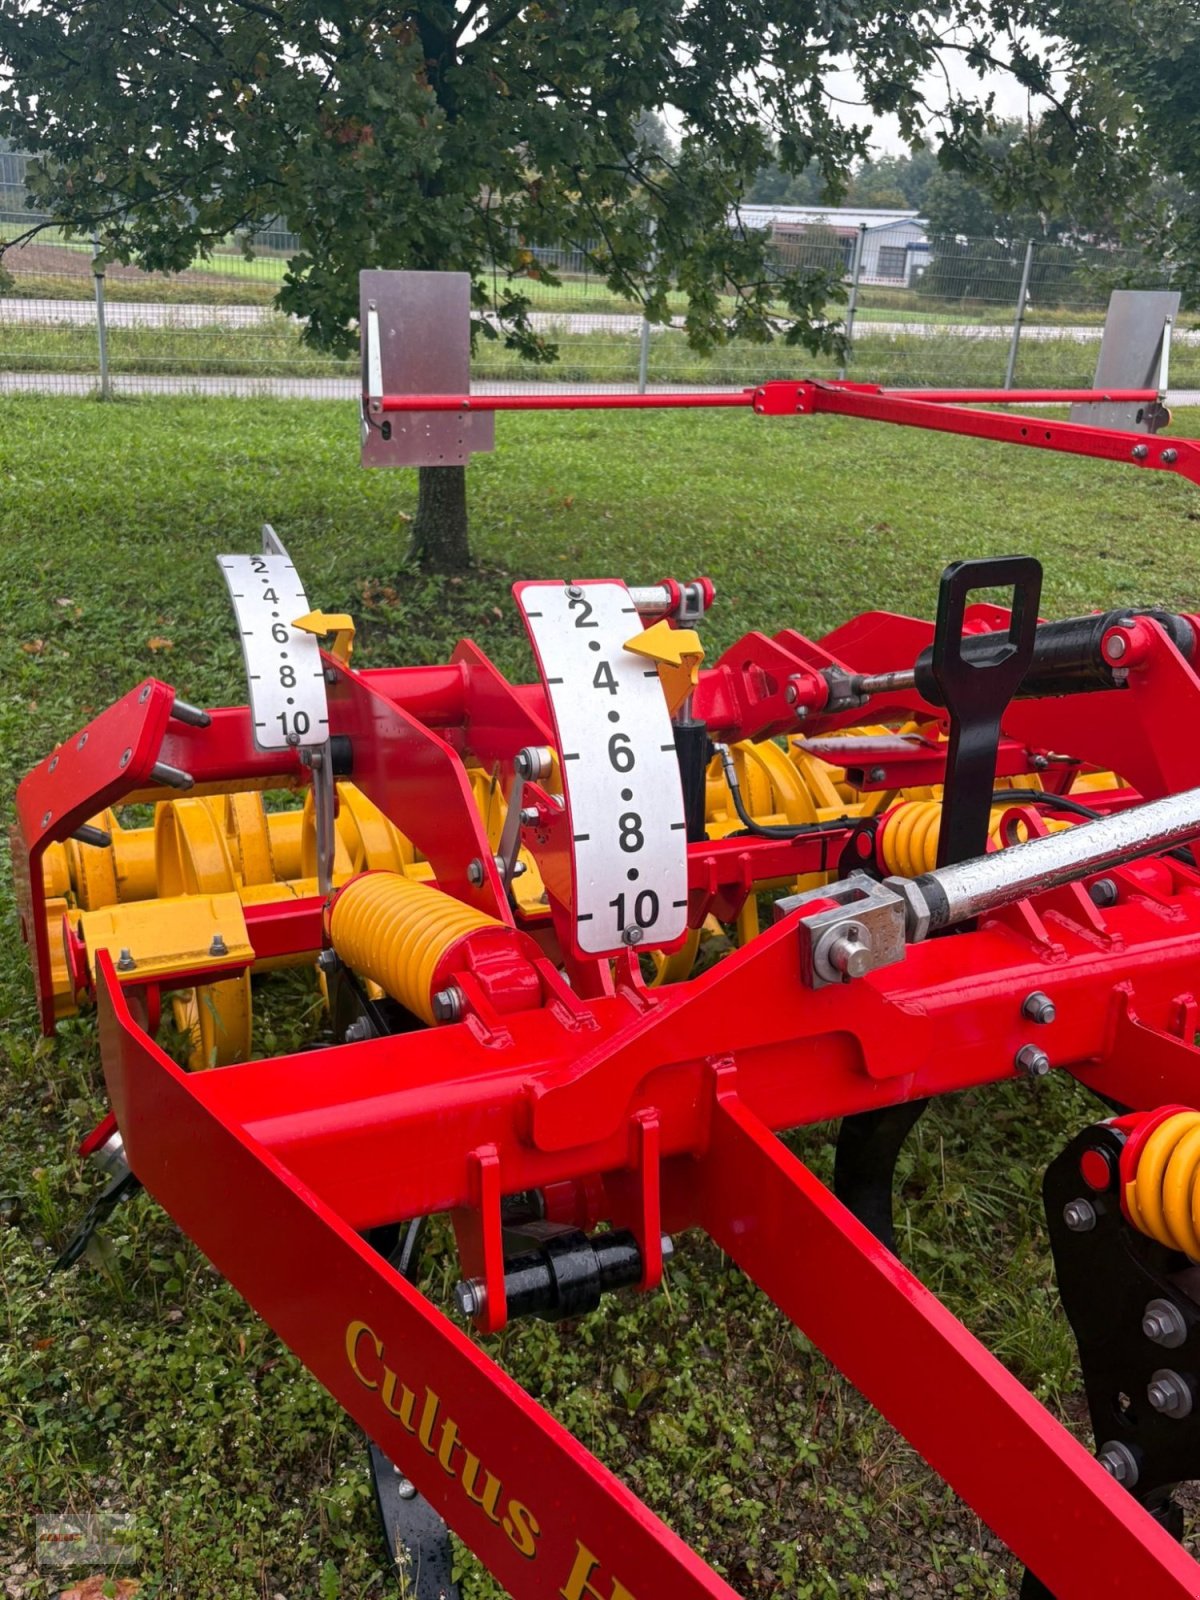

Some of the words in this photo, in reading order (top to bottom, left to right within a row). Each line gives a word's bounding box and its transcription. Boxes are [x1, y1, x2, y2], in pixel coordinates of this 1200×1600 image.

[251, 561, 269, 573] 2
[263, 588, 279, 604] 4
[568, 599, 599, 628] 2
[272, 623, 289, 644] 6
[280, 665, 296, 688] 8
[592, 661, 619, 695] 4
[276, 711, 310, 735] 10
[608, 733, 635, 773] 6
[619, 812, 644, 853] 8
[609, 889, 660, 931] 10
[346, 1321, 540, 1558] Cultus
